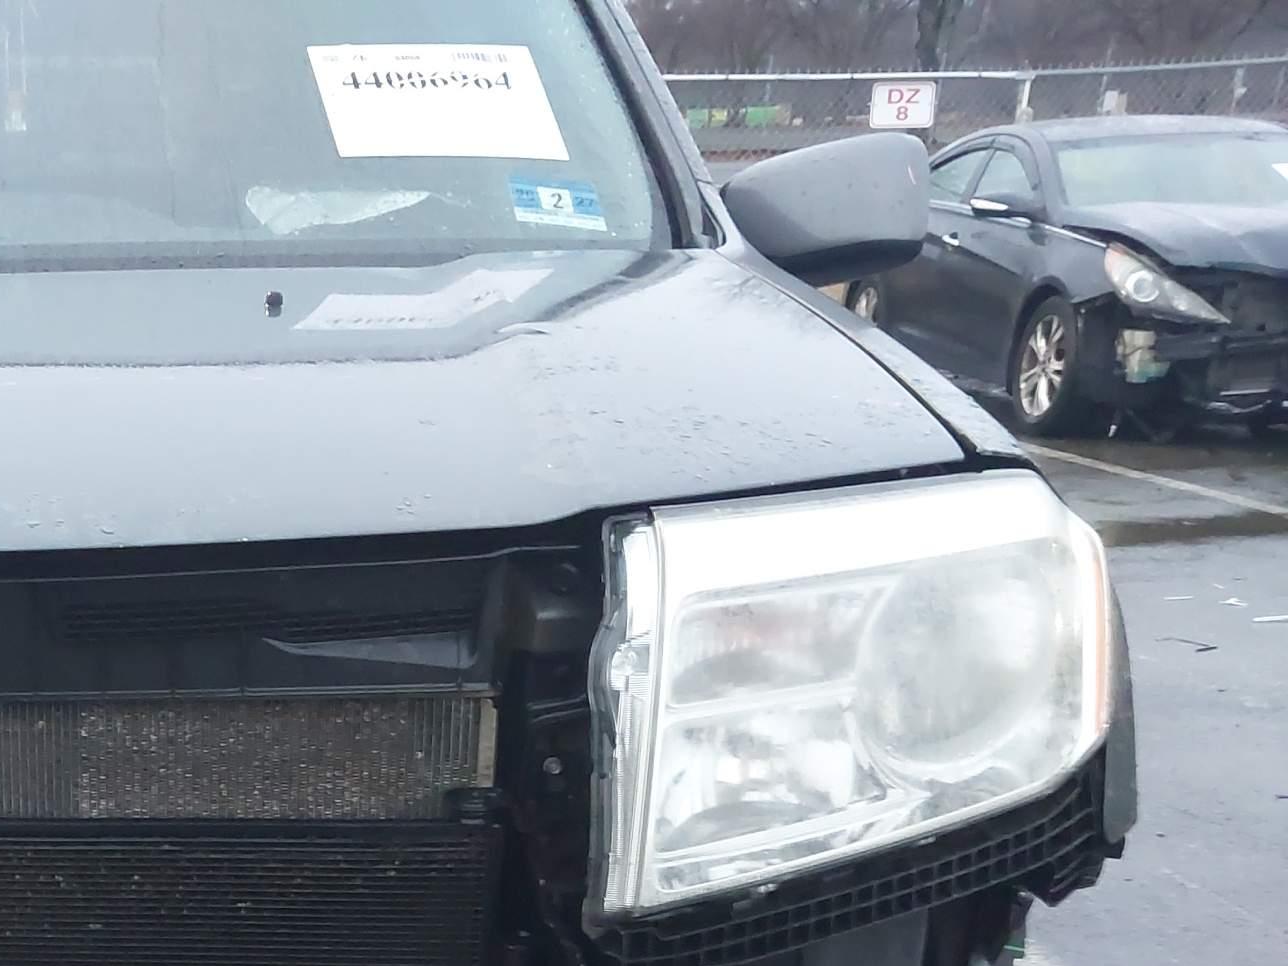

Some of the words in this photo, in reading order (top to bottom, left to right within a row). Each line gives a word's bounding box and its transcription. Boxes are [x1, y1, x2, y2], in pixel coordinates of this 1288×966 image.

[887, 88, 921, 105] DZ
[896, 106, 908, 121] 8
[550, 192, 564, 209] 2
